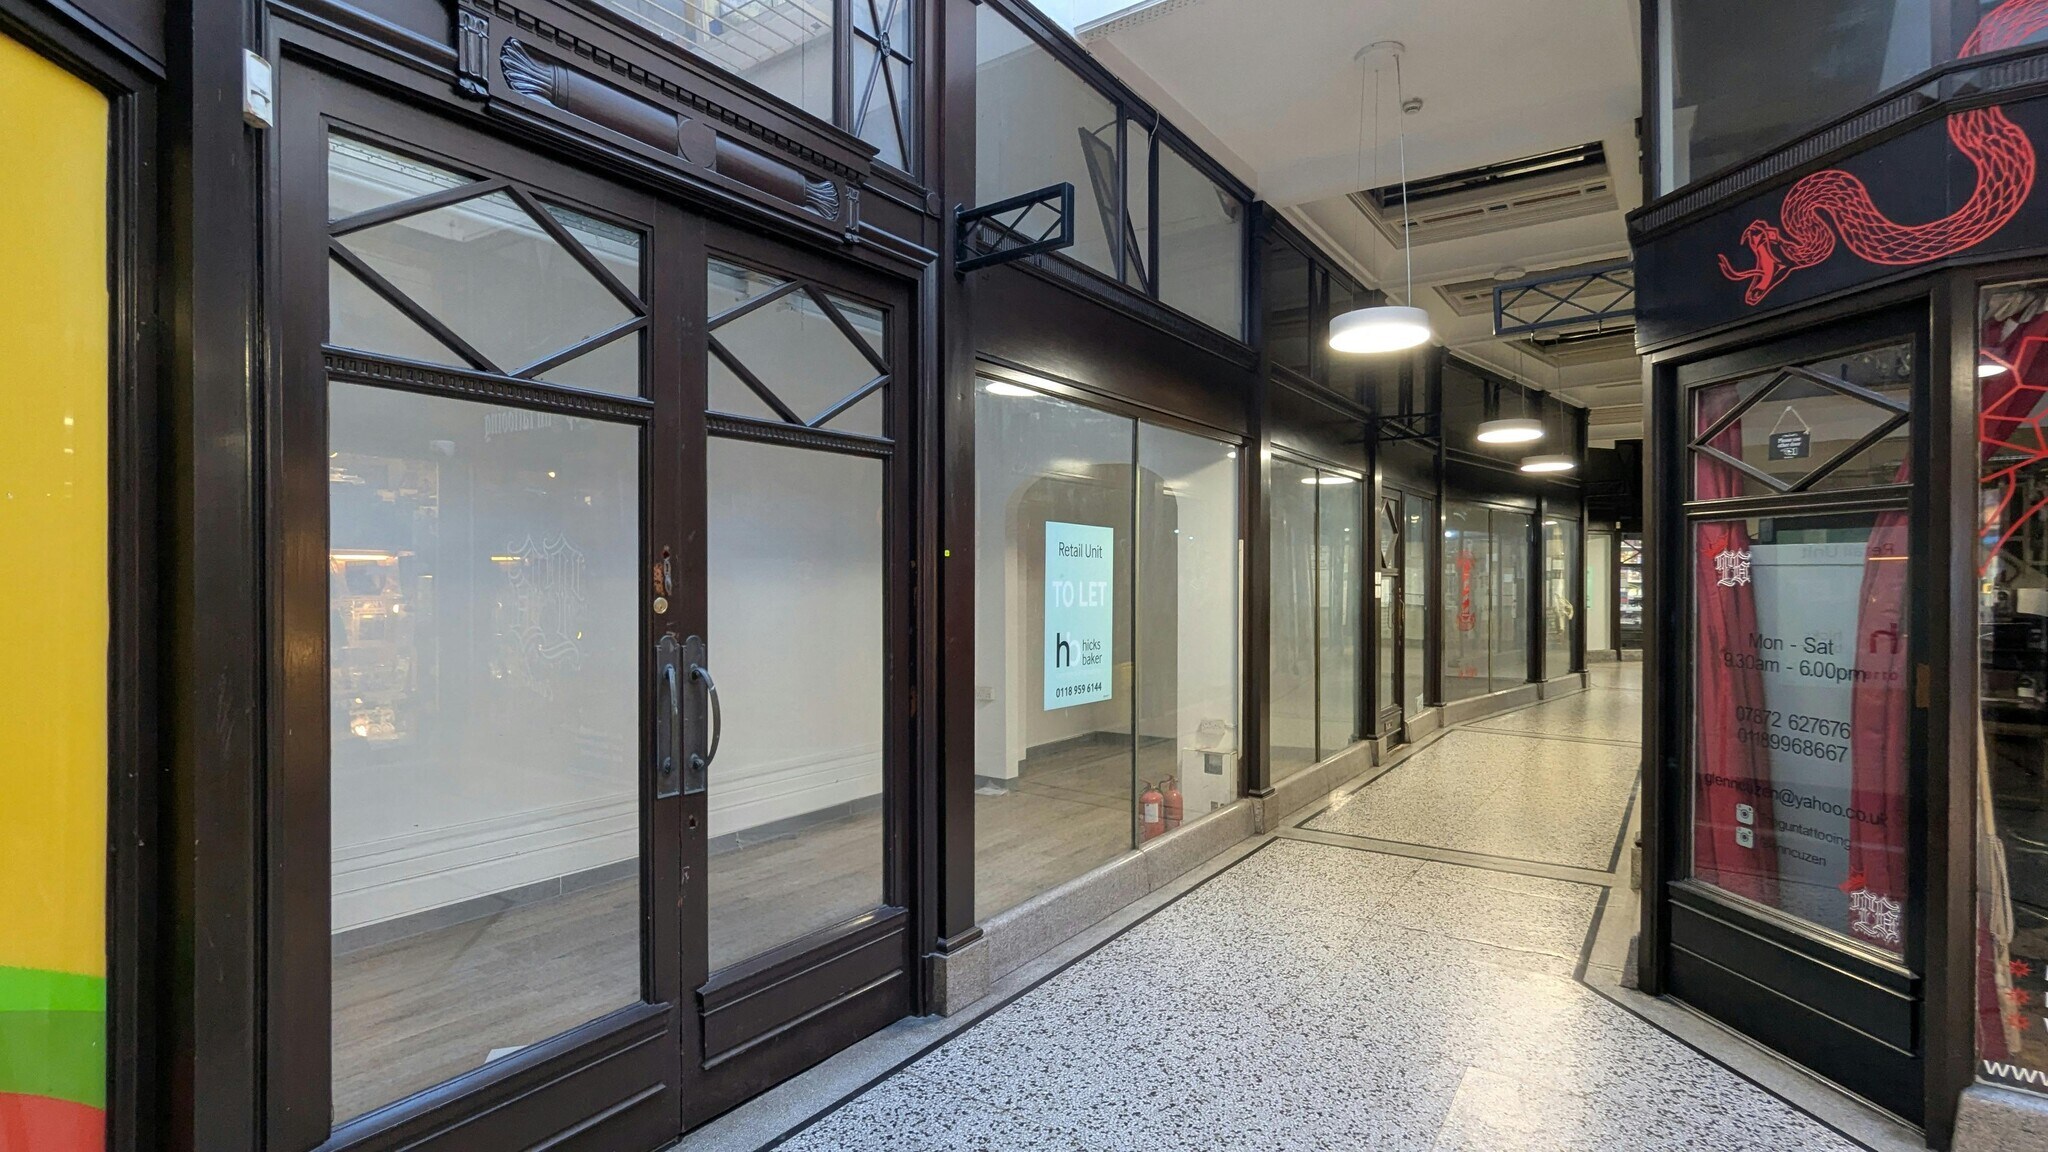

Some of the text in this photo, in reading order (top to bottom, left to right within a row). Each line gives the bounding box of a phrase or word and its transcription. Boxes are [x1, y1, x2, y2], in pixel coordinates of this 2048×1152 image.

[1058, 541, 1103, 559] Retail Unit
[1052, 580, 1107, 608] TO LET
[1082, 639, 1101, 651] hicks
[1750, 633, 1783, 651] Mon
[1803, 637, 1834, 655] Sat
[1082, 652, 1103, 666] baker
[1723, 652, 1780, 673] 9.30am
[1799, 660, 1866, 684] 6.00pm
[1056, 682, 1102, 698] 0118 959 6144
[1736, 705, 1850, 740] 07872 627676
[1737, 727, 1848, 763] 01189968667
